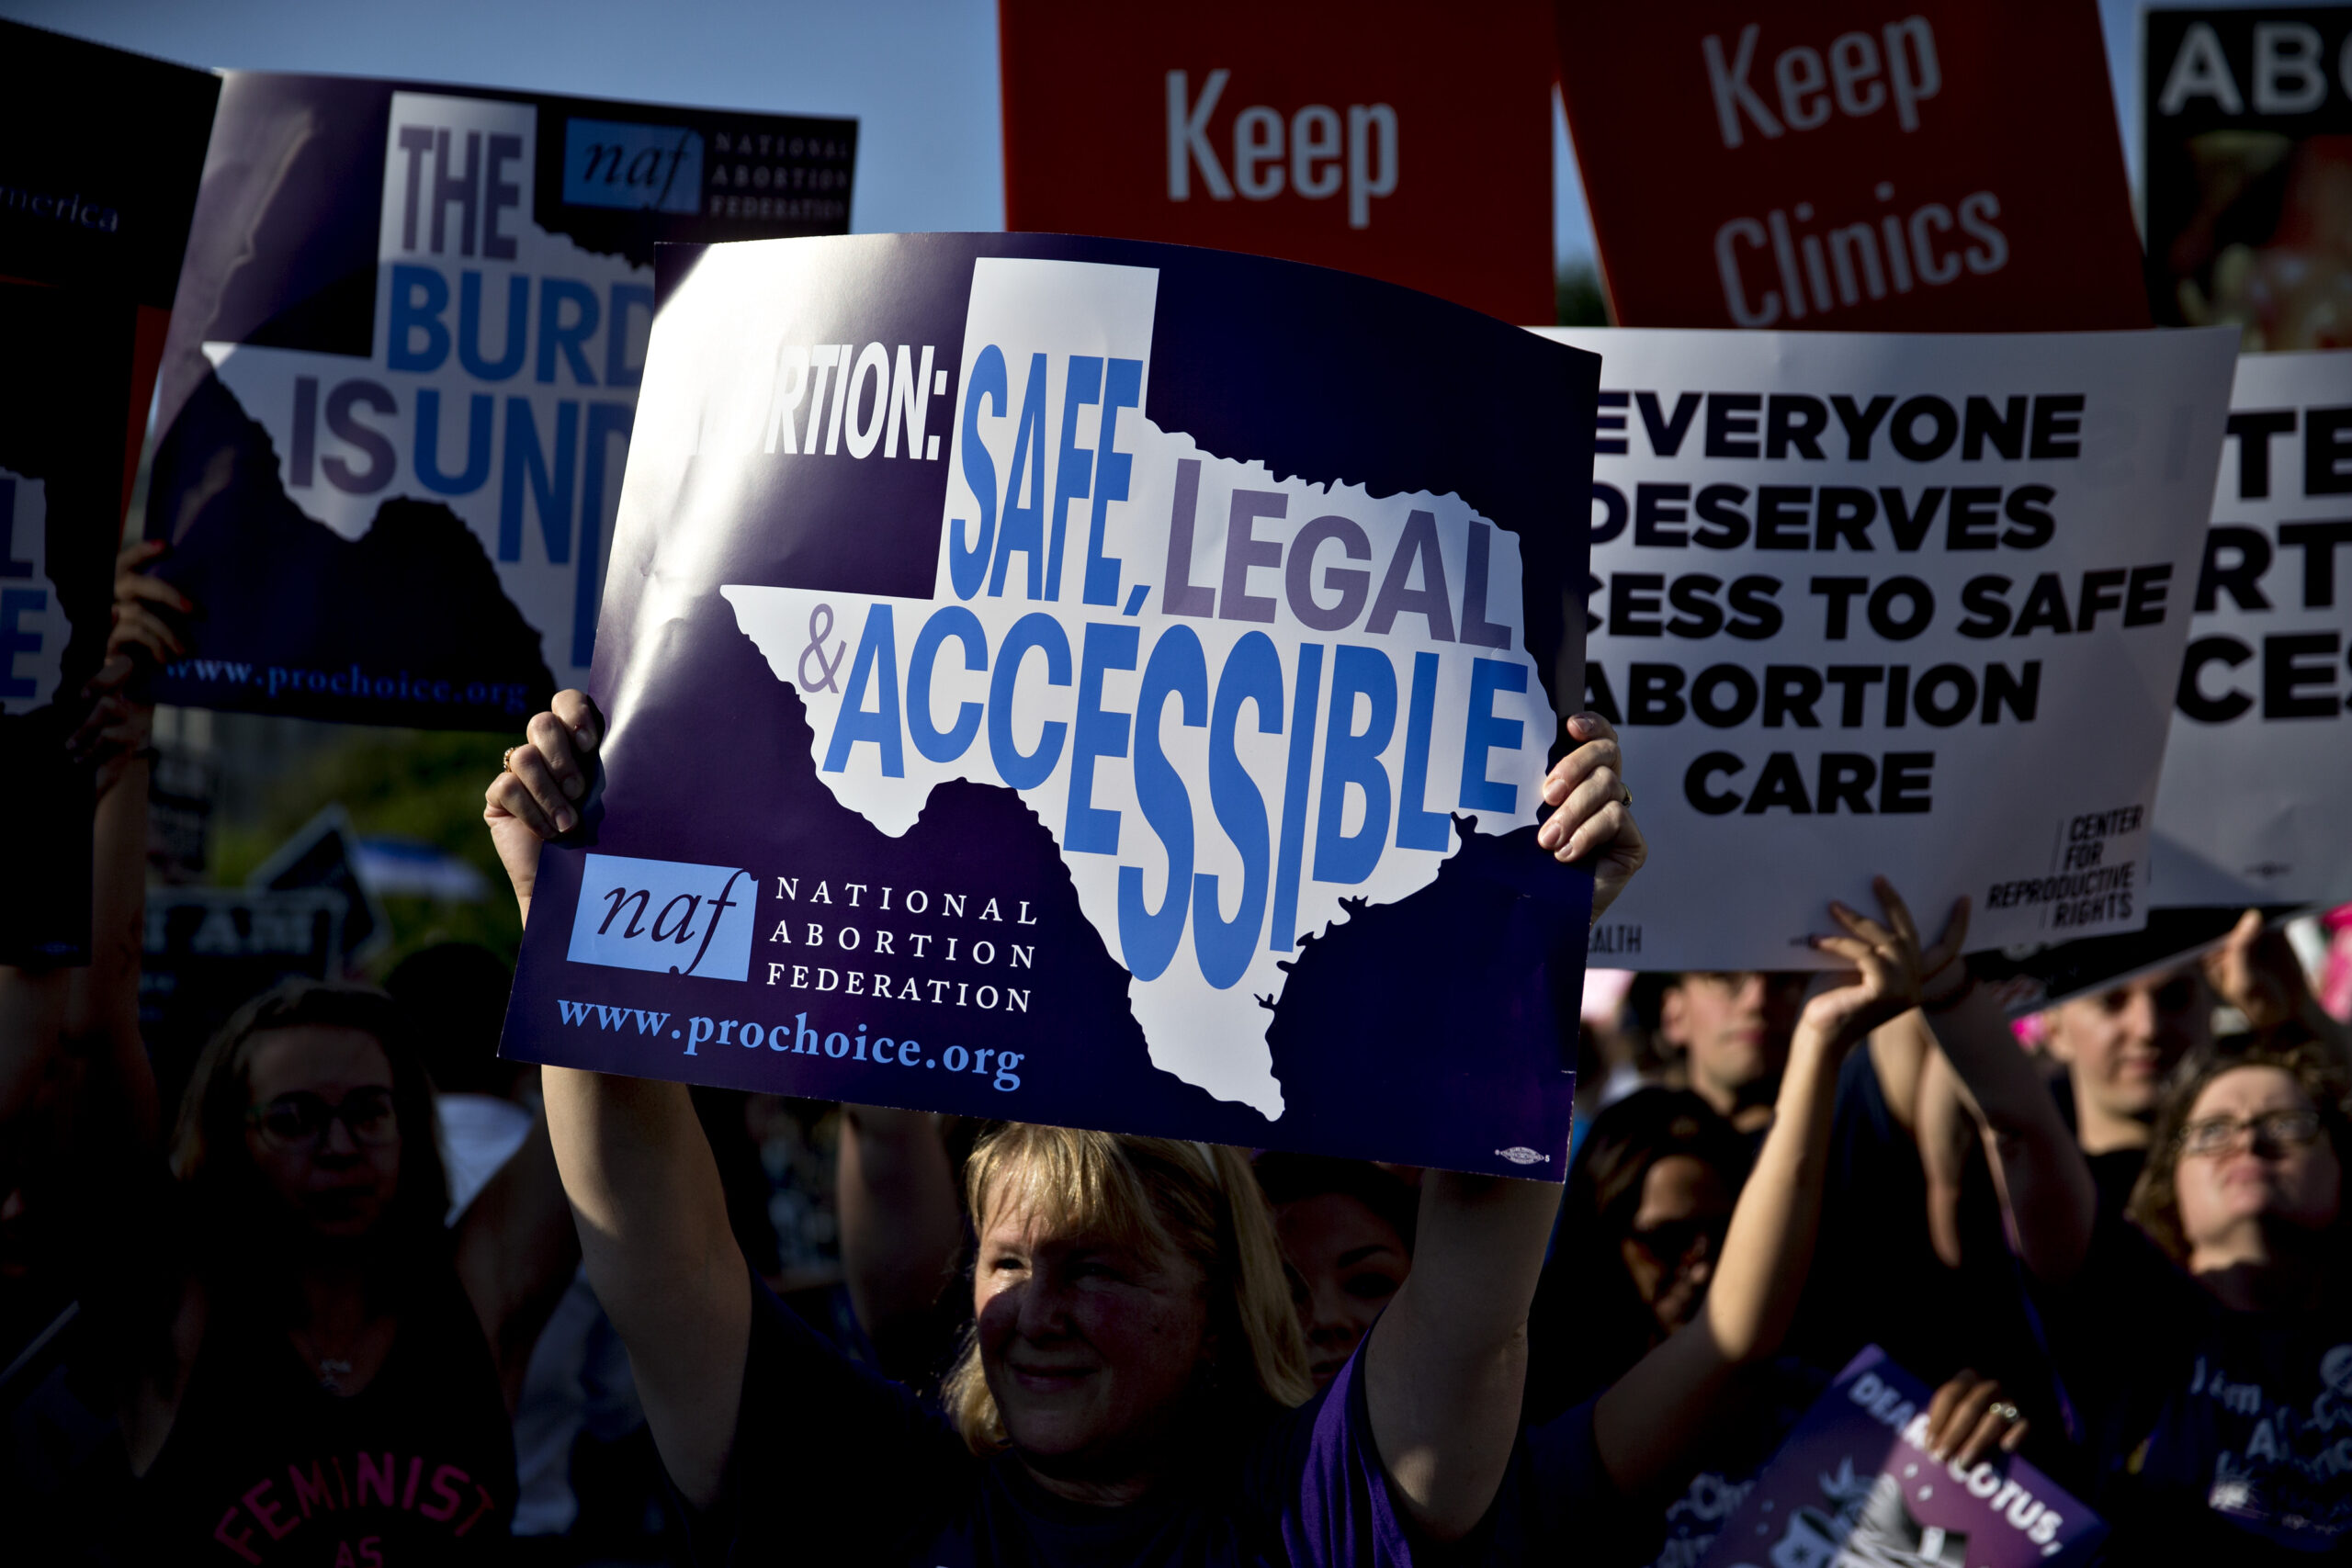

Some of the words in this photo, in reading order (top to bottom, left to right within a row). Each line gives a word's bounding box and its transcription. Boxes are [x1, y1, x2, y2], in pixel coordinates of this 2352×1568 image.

[1702, 16, 1943, 148] Keep
[2158, 20, 2352, 116] AB
[1165, 69, 1399, 229] Keep
[0, 186, 119, 233] merica
[399, 124, 524, 261] THE
[1713, 182, 2010, 330] Clinics
[289, 376, 399, 496] IS
[763, 341, 948, 461] RTION:
[1595, 390, 2086, 461] EVERYONE
[948, 344, 1152, 616] SAFE,
[1590, 480, 2056, 551] DESERVES
[1160, 459, 1511, 650] LEGAL
[1810, 575, 1936, 641] TO
[1957, 563, 2175, 639] SAFE
[166, 658, 528, 716] www.prochoice.org
[1584, 660, 2042, 728] ABORTION
[797, 602, 845, 694] &
[822, 604, 1529, 990] ACCESSIBLE
[1683, 750, 1936, 816] CARE
[2064, 840, 2104, 871] FOR
[2070, 805, 2144, 841] CENTER
[775, 875, 1038, 925] NATIONAL
[1985, 861, 2135, 909] REPRODUCTIVE
[2052, 891, 2133, 929] RIGHTS
[596, 869, 759, 977] naf
[769, 919, 1035, 970] ABORTION
[1588, 925, 1643, 953] ALTH
[765, 963, 1031, 1014] FEDERATION
[556, 998, 1025, 1092] www.prochoice.org
[214, 1450, 494, 1565] FEMINIST
[334, 1535, 384, 1568] AS
